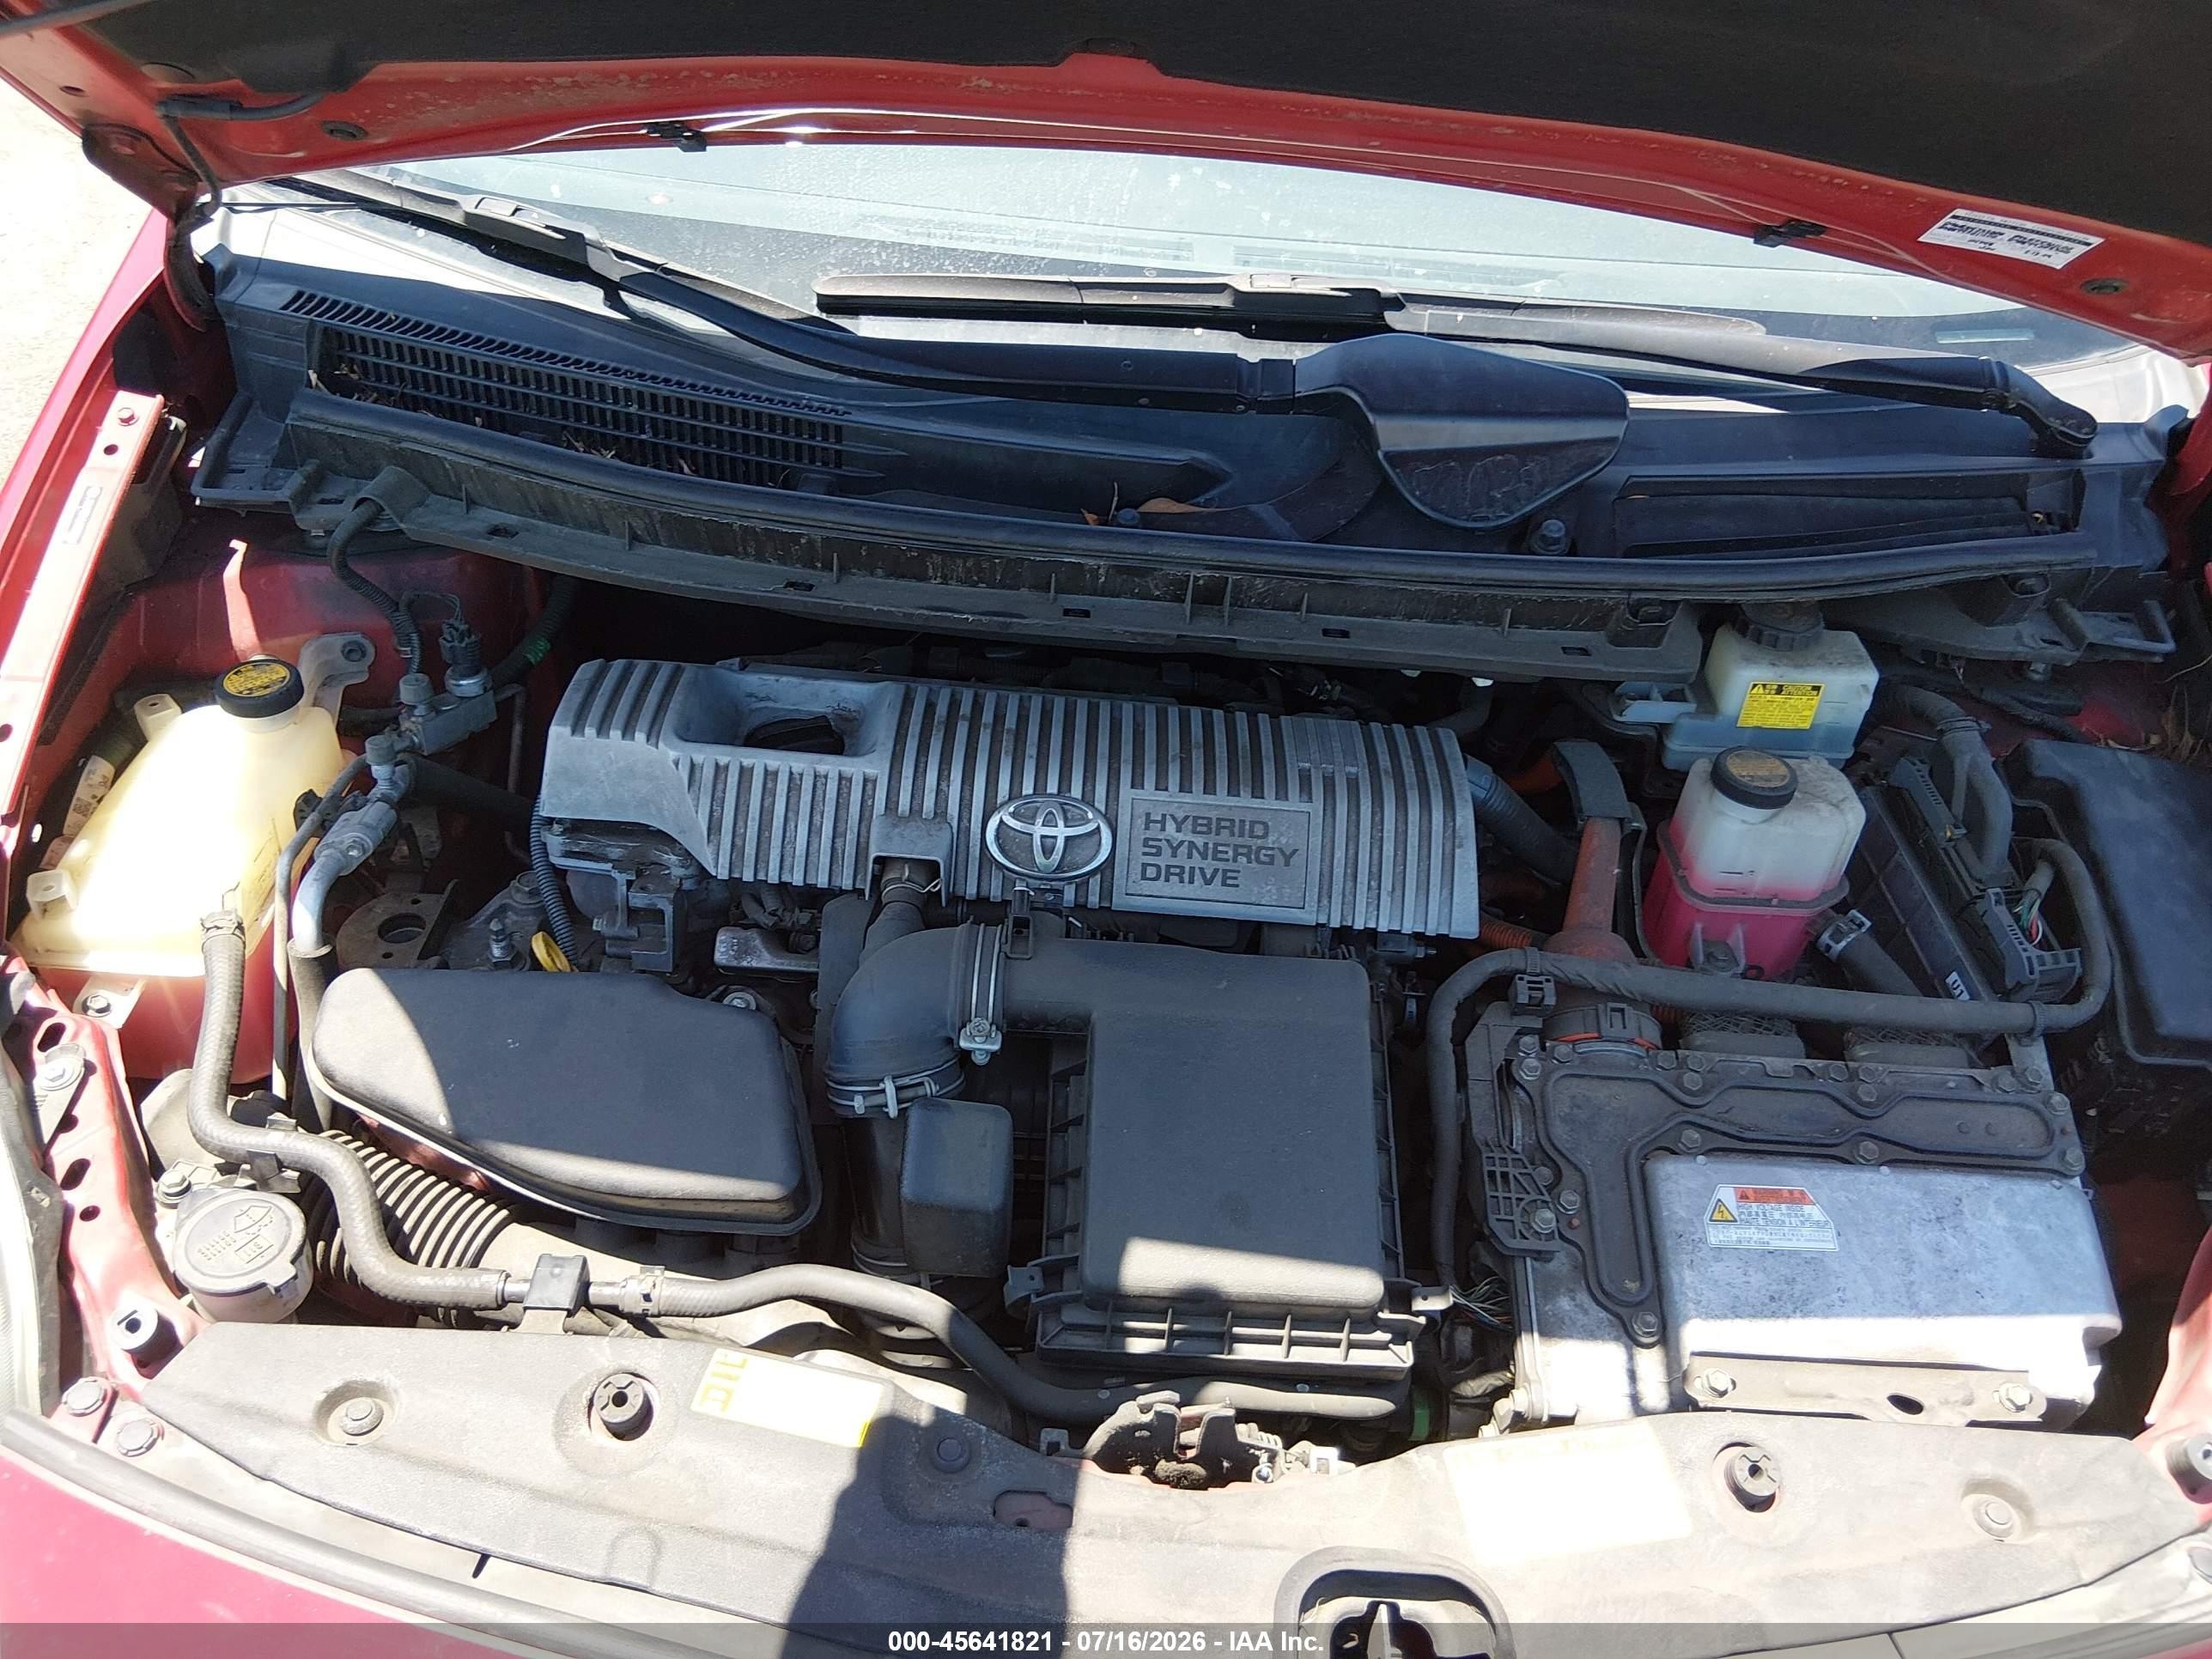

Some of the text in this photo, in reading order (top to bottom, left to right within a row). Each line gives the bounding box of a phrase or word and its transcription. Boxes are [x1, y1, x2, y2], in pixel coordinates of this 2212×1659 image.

[1144, 812, 1269, 840] HYBRID
[1141, 836, 1299, 867] SYNERGY
[1139, 862, 1242, 888] DRIVE
